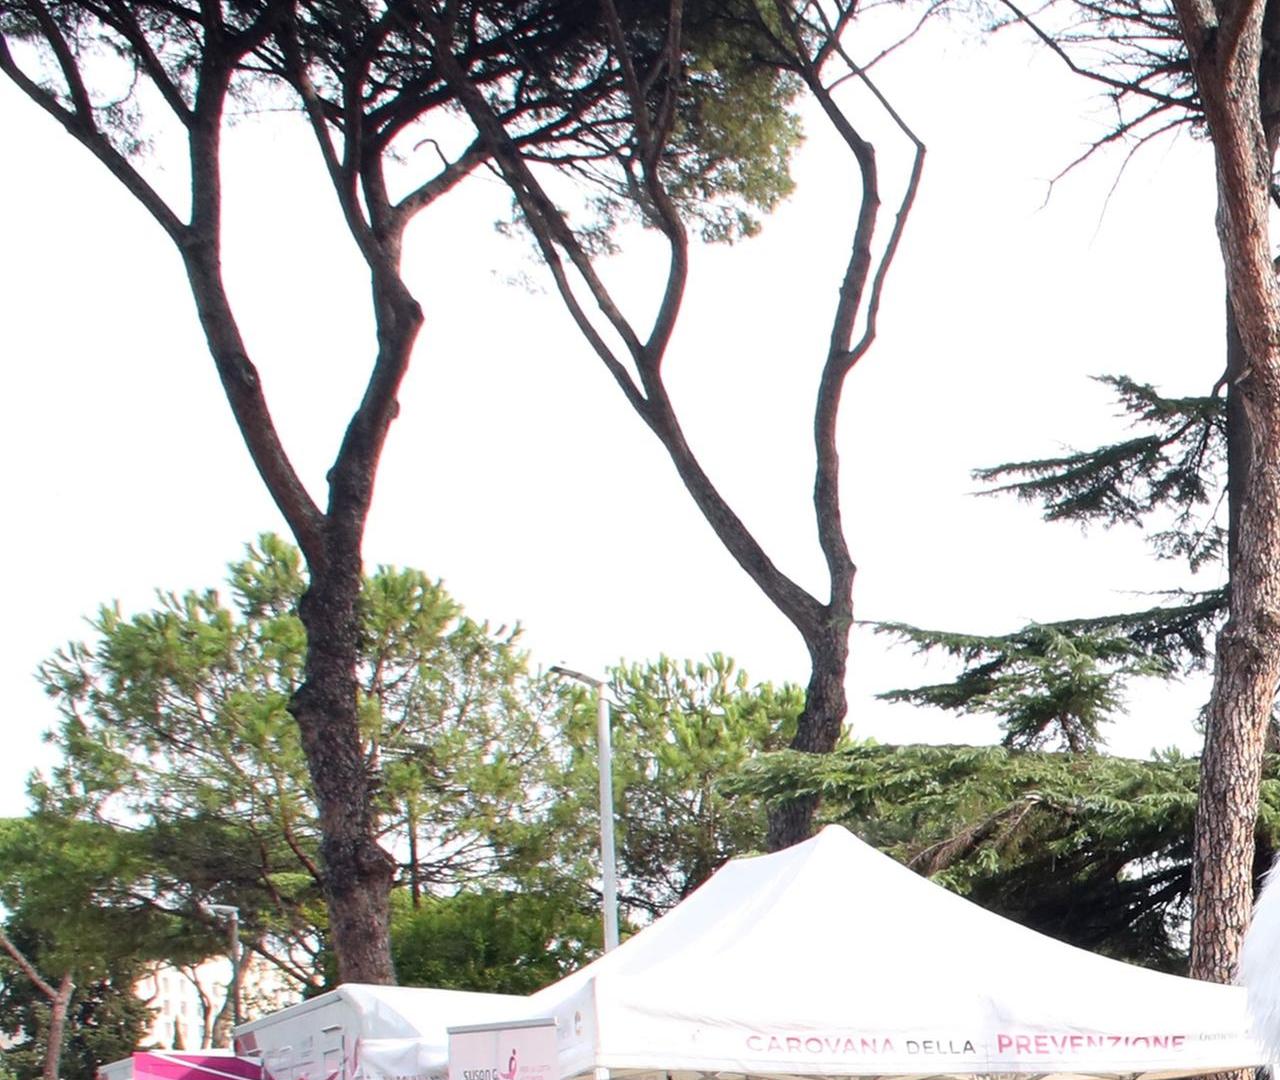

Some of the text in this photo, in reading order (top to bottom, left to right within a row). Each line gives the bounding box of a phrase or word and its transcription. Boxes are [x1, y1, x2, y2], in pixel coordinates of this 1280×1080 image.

[745, 1033, 1186, 1055] CAROVANA DELLA PREVENZIONE
